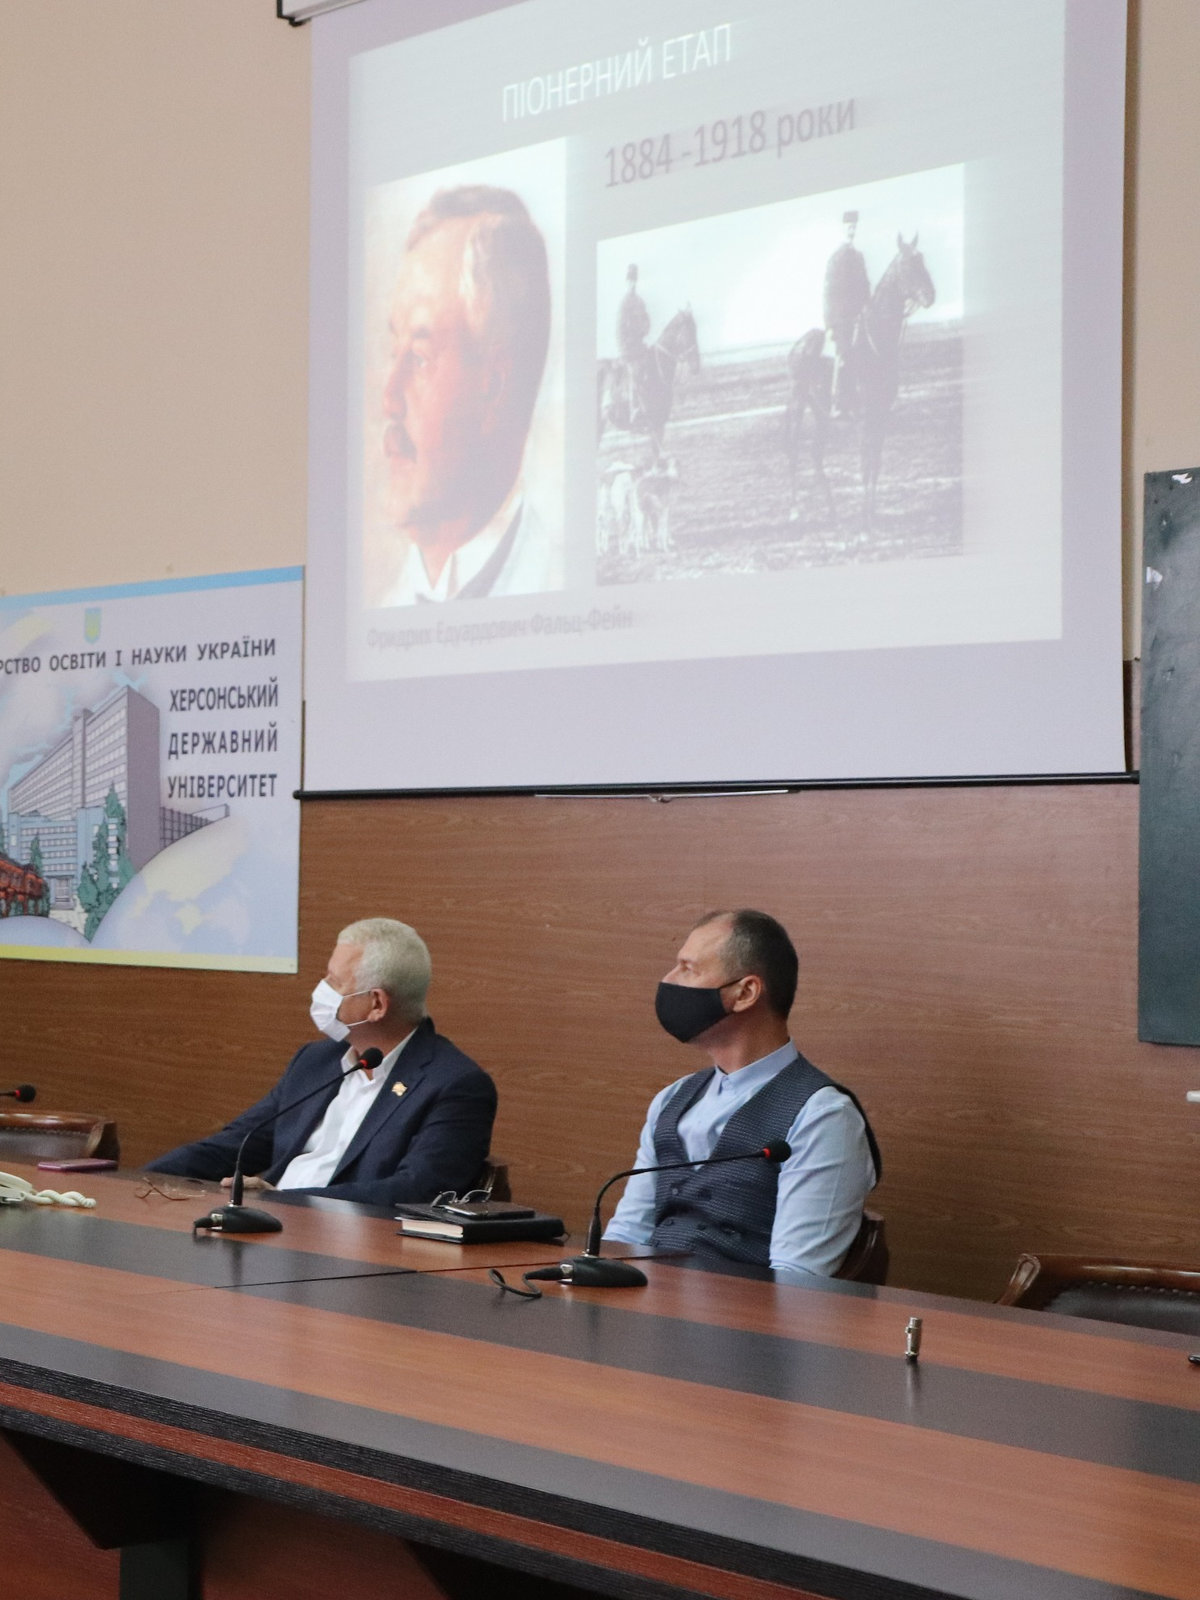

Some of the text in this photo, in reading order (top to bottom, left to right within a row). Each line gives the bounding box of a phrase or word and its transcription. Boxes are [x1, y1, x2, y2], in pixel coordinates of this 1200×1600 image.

[502, 23, 732, 123] ПІОНЕРНИЙ ЕТАП
[776, 98, 857, 159] роки
[49, 651, 107, 672] ОСВІТИ
[115, 649, 123, 667] І
[131, 644, 188, 667] НАУКИ
[197, 635, 276, 662] УКРАЇНИ
[168, 676, 279, 713] ХЕРСОНСЬКИЙ
[167, 721, 279, 760] ДЕРЖАВНИЙ
[167, 773, 278, 799] УНІВЕРСИТЕТ
